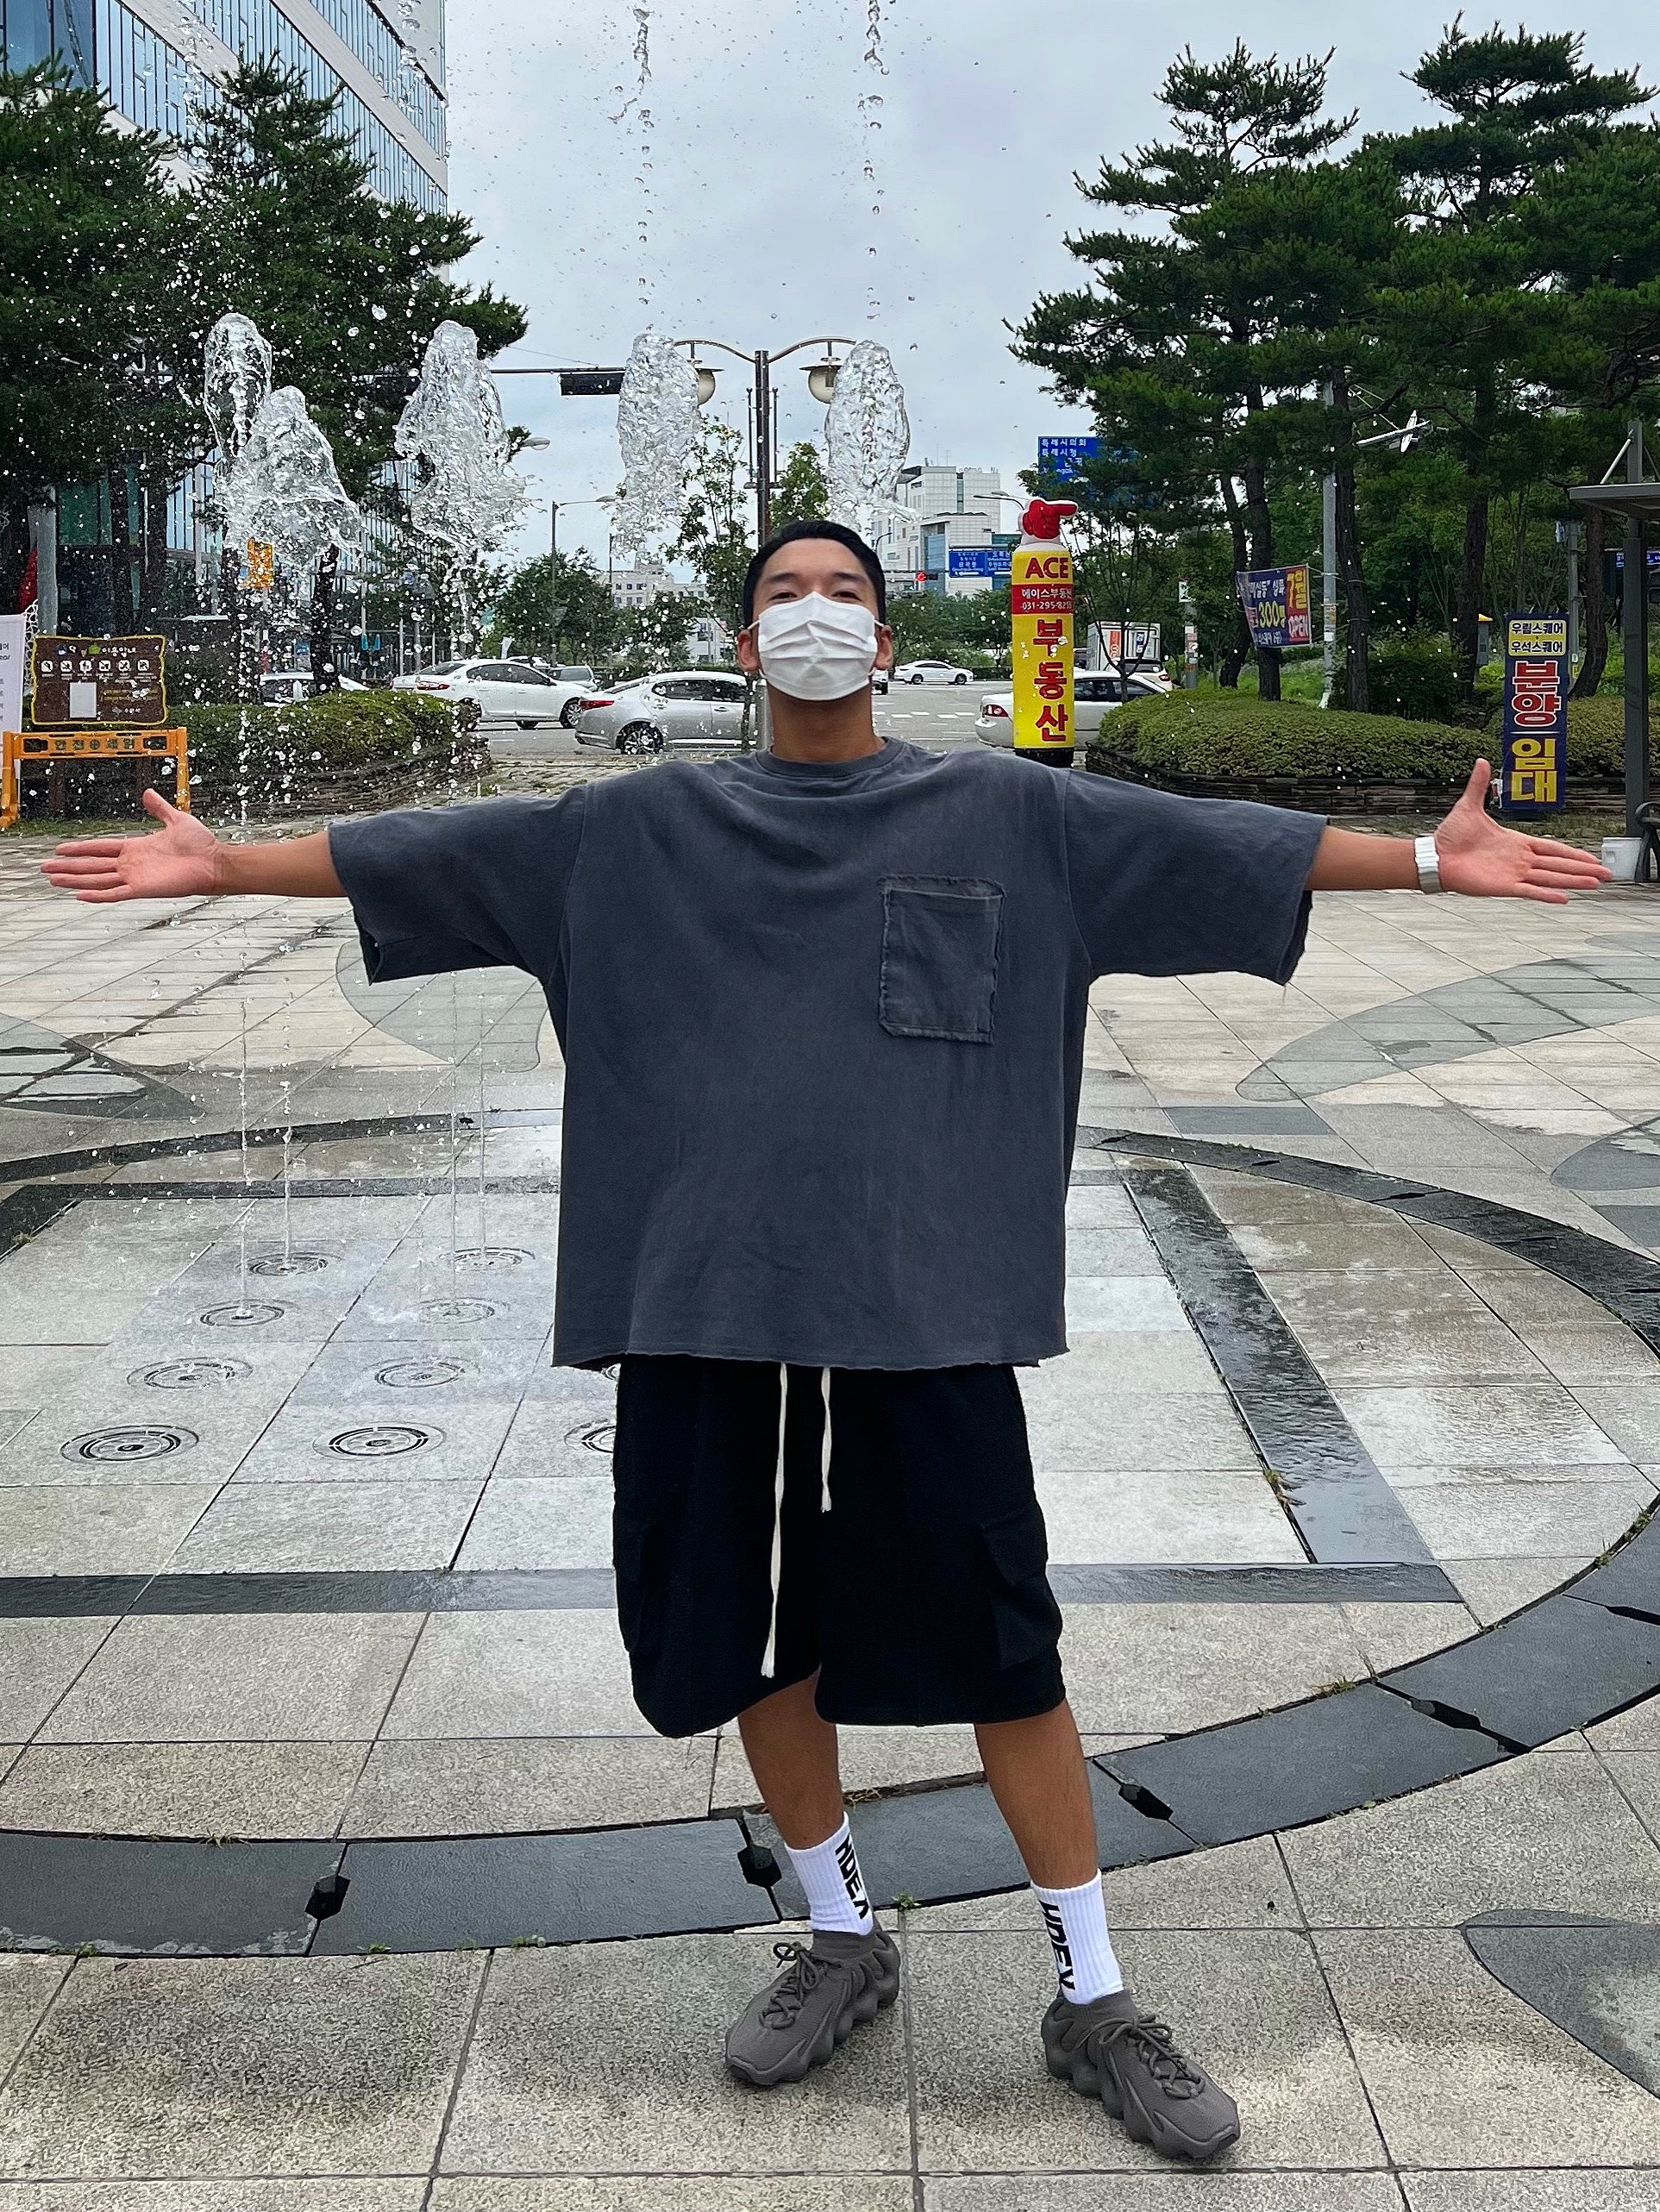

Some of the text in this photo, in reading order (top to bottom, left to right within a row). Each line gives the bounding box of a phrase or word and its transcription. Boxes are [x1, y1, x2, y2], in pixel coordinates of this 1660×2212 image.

[1024, 557, 1069, 579] ACE
[1287, 569, 1307, 610] 7월
[1511, 622, 1563, 635] 우림스퀘어
[1511, 640, 1563, 653] 우석스퀘어
[1032, 618, 1068, 743] 부동산
[1512, 660, 1562, 727] 분양
[1511, 737, 1558, 803] 임대
